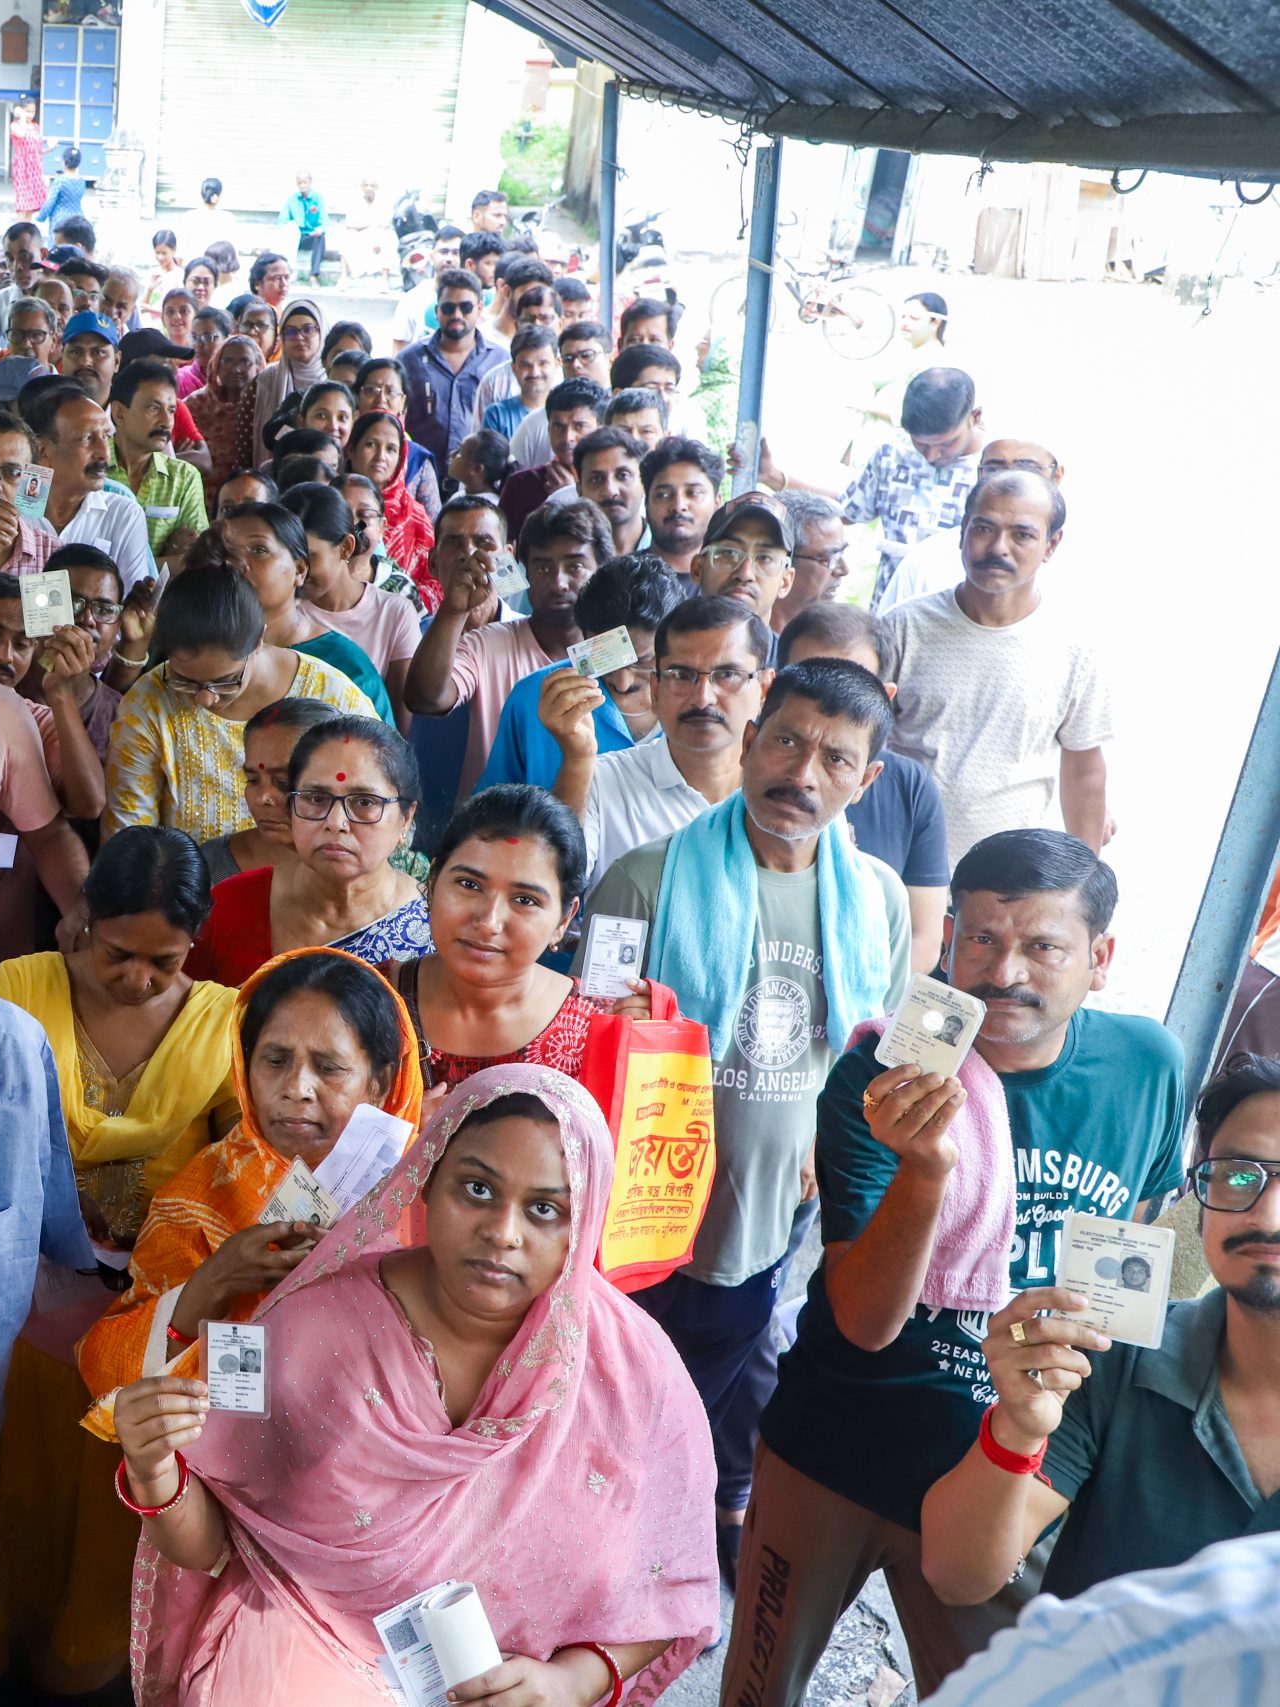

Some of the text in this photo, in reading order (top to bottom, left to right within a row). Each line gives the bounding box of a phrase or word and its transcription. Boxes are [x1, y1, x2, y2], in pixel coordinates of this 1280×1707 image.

[759, 941, 823, 978] UNDERS
[713, 1067, 817, 1092] LOS ANGELES
[739, 1092, 802, 1102] CALIFORNIA
[629, 1121, 711, 1180] জয়ন্তী
[1013, 1148, 1130, 1217] MSBURG
[1016, 1192, 1069, 1201] OM BUILDS
[1080, 1231, 1105, 1239] ELECTION
[1009, 1230, 1062, 1279] PL
[931, 1340, 950, 1355] 22
